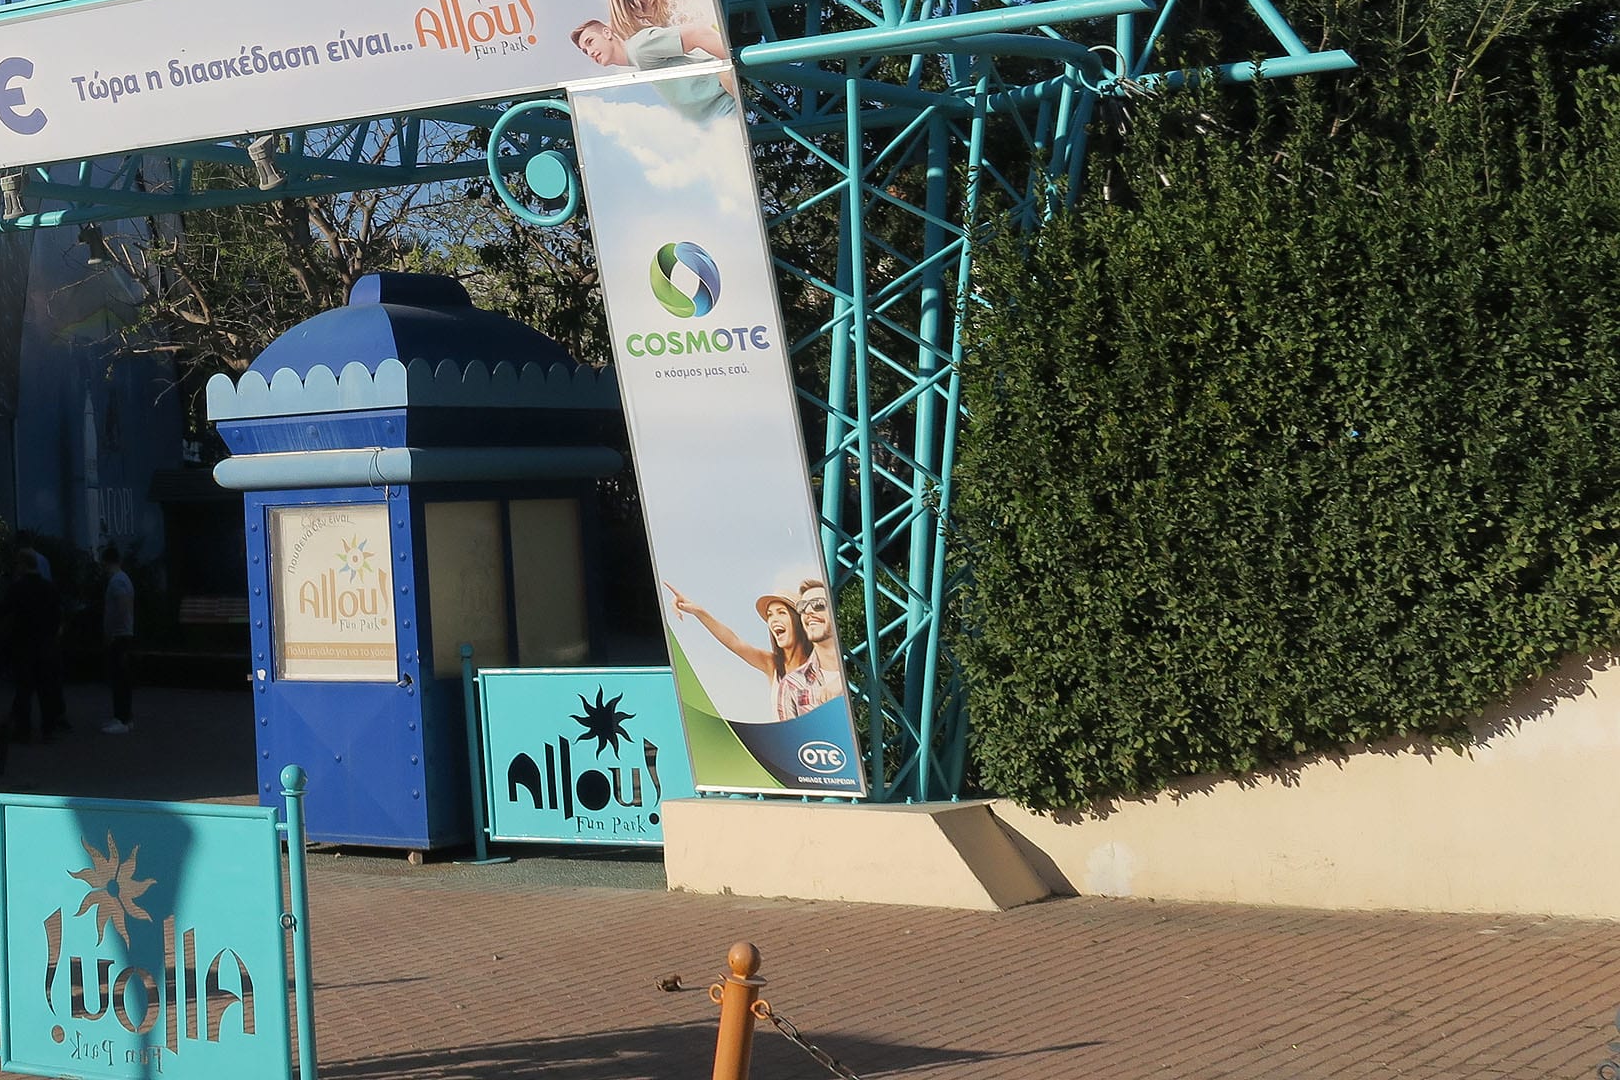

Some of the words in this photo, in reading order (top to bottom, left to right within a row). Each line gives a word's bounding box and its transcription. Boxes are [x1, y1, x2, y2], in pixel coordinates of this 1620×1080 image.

[473, 44, 497, 60] Fun
[501, 36, 529, 55] Park
[71, 71, 140, 103] Τώρα
[145, 70, 163, 90] η
[167, 45, 320, 87] διασκέδαση
[626, 325, 771, 357] COSMOTE
[664, 366, 702, 379] κόσμος
[299, 568, 389, 626] Allou!
[339, 618, 357, 632] Fun
[360, 618, 380, 632] Park
[802, 748, 842, 767] OTE
[507, 735, 661, 825] Allou!
[575, 815, 605, 834] Fun
[612, 814, 647, 834] Park
